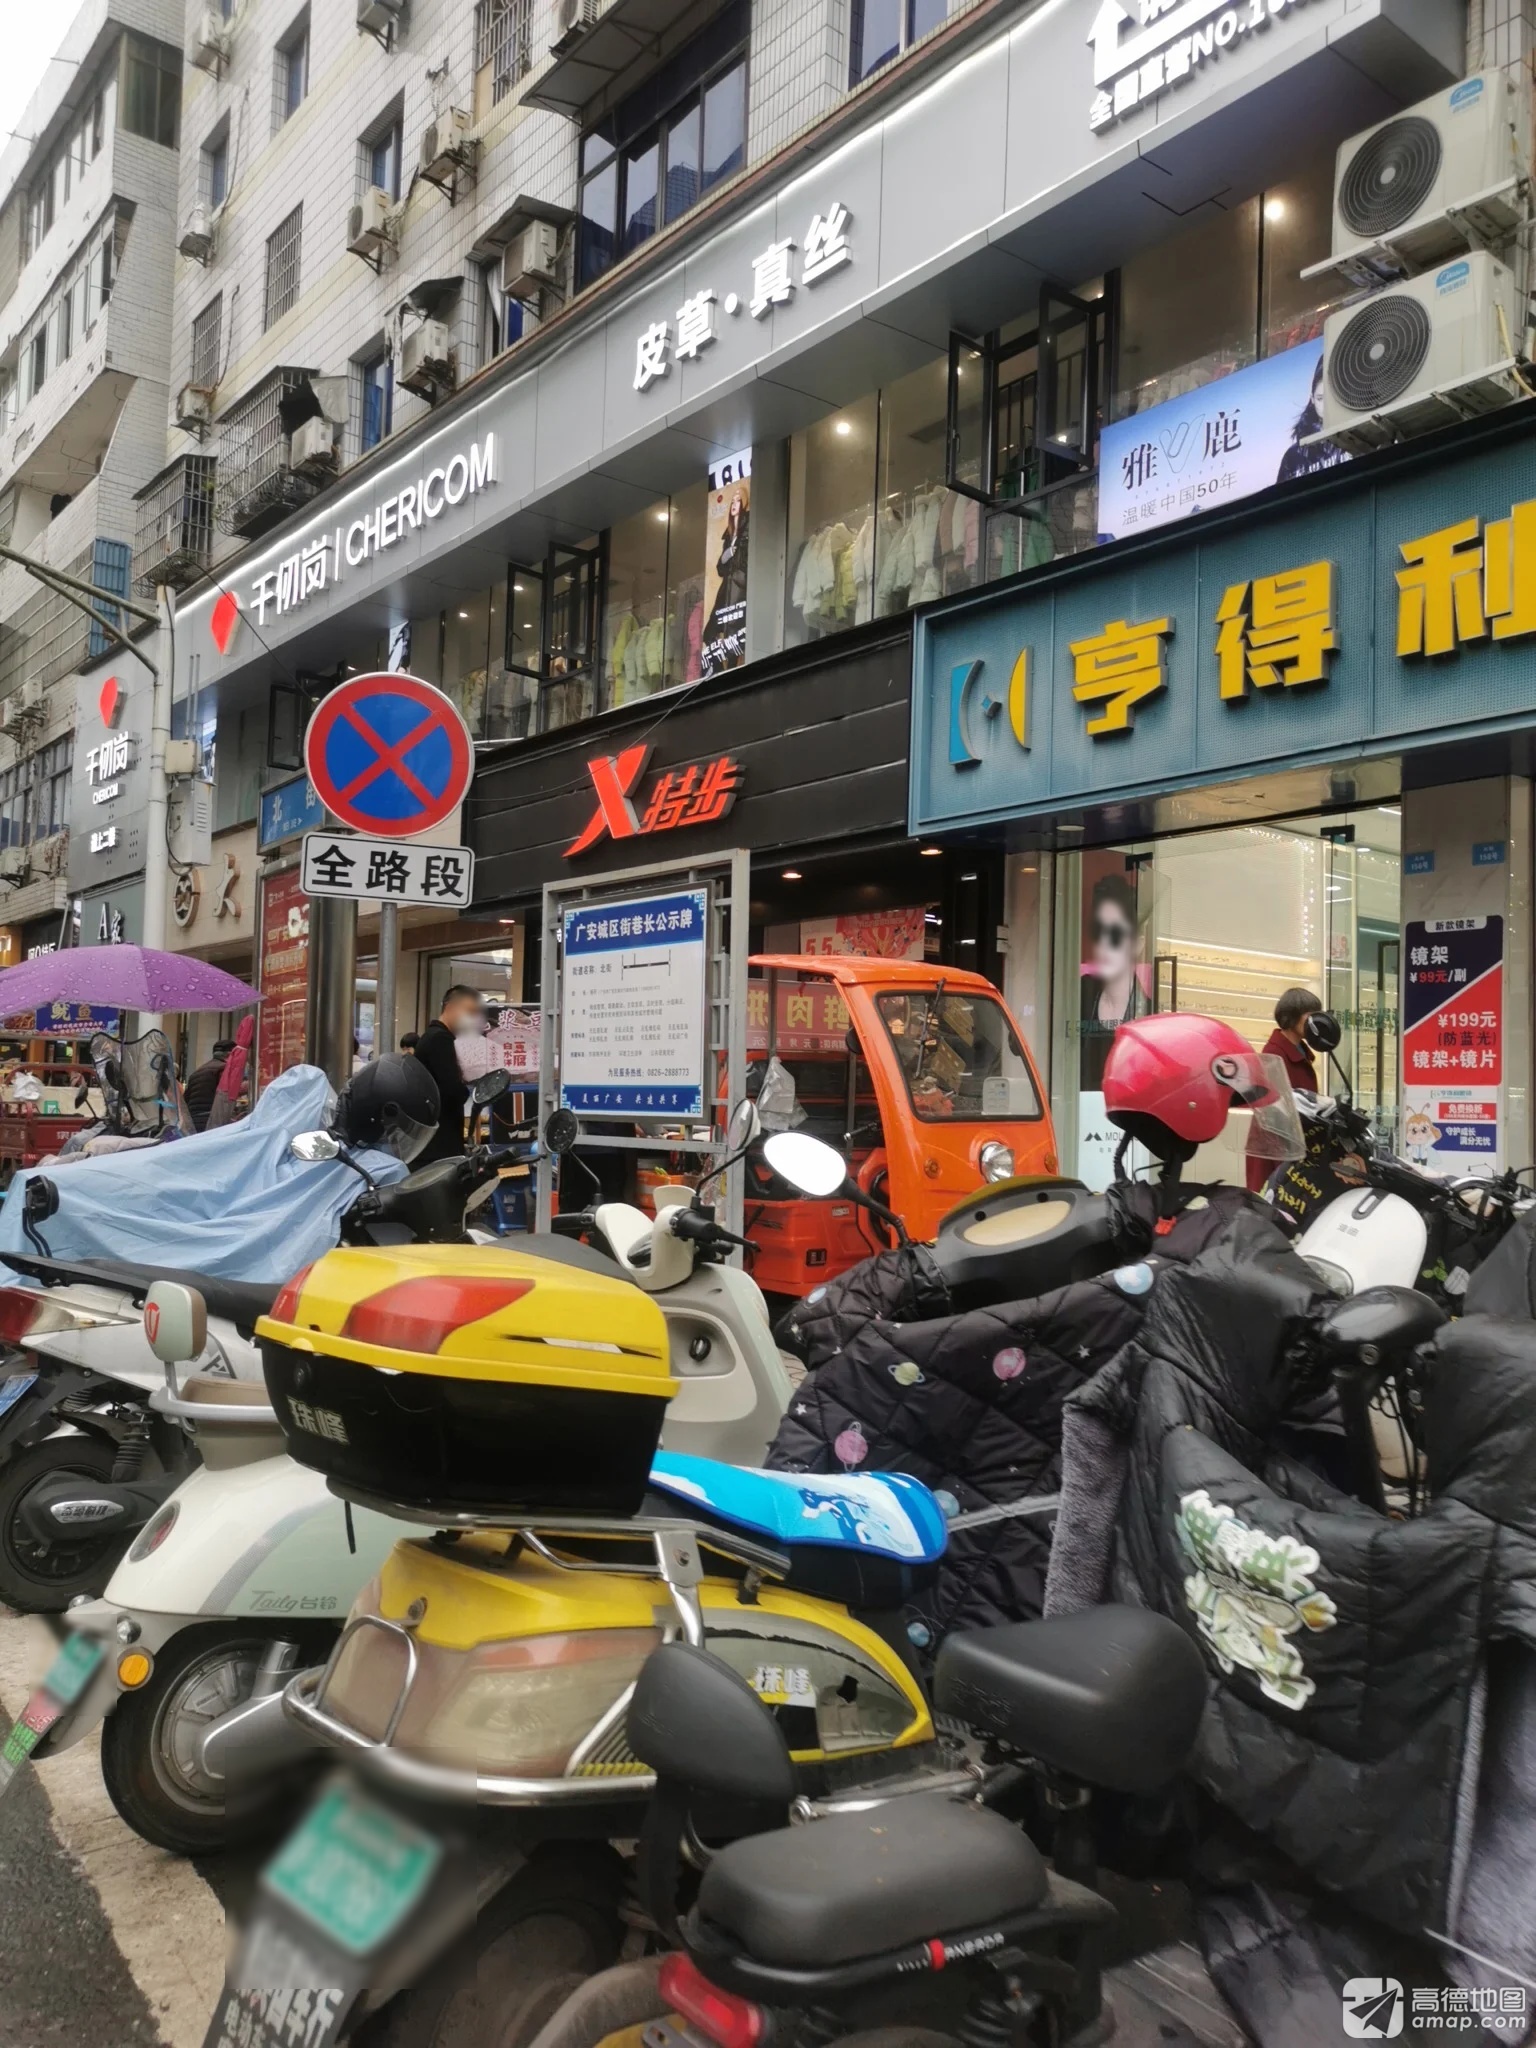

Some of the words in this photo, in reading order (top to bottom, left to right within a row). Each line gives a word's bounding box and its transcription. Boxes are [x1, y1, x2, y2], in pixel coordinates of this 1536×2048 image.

[633, 203, 848, 390] 皮草·真丝
[1122, 443, 1159, 491] 雅
[1203, 408, 1243, 463] 鹿
[1121, 470, 1238, 527] 温暖中国50年
[251, 534, 328, 626] 千仞岗
[345, 432, 495, 566] CHERICOM
[1069, 500, 1536, 736] 亨得利
[85, 731, 128, 785] 千仞岗
[638, 755, 739, 834] 特步
[311, 844, 465, 898] 全路段
[575, 908, 693, 942] 广安城区街巷长公示牌
[1435, 919, 1476, 931] 新款镜架
[1410, 946, 1449, 966] 镜架
[50, 1002, 94, 1022] 鱿鱼
[1412, 1049, 1497, 1069] 镜架+镜片
[1448, 1104, 1484, 1114] 免费换新
[1445, 1126, 1477, 1137] 守护成长
[1459, 1136, 1491, 1147] 满分无忧
[300, 1595, 338, 1610] 台铃
